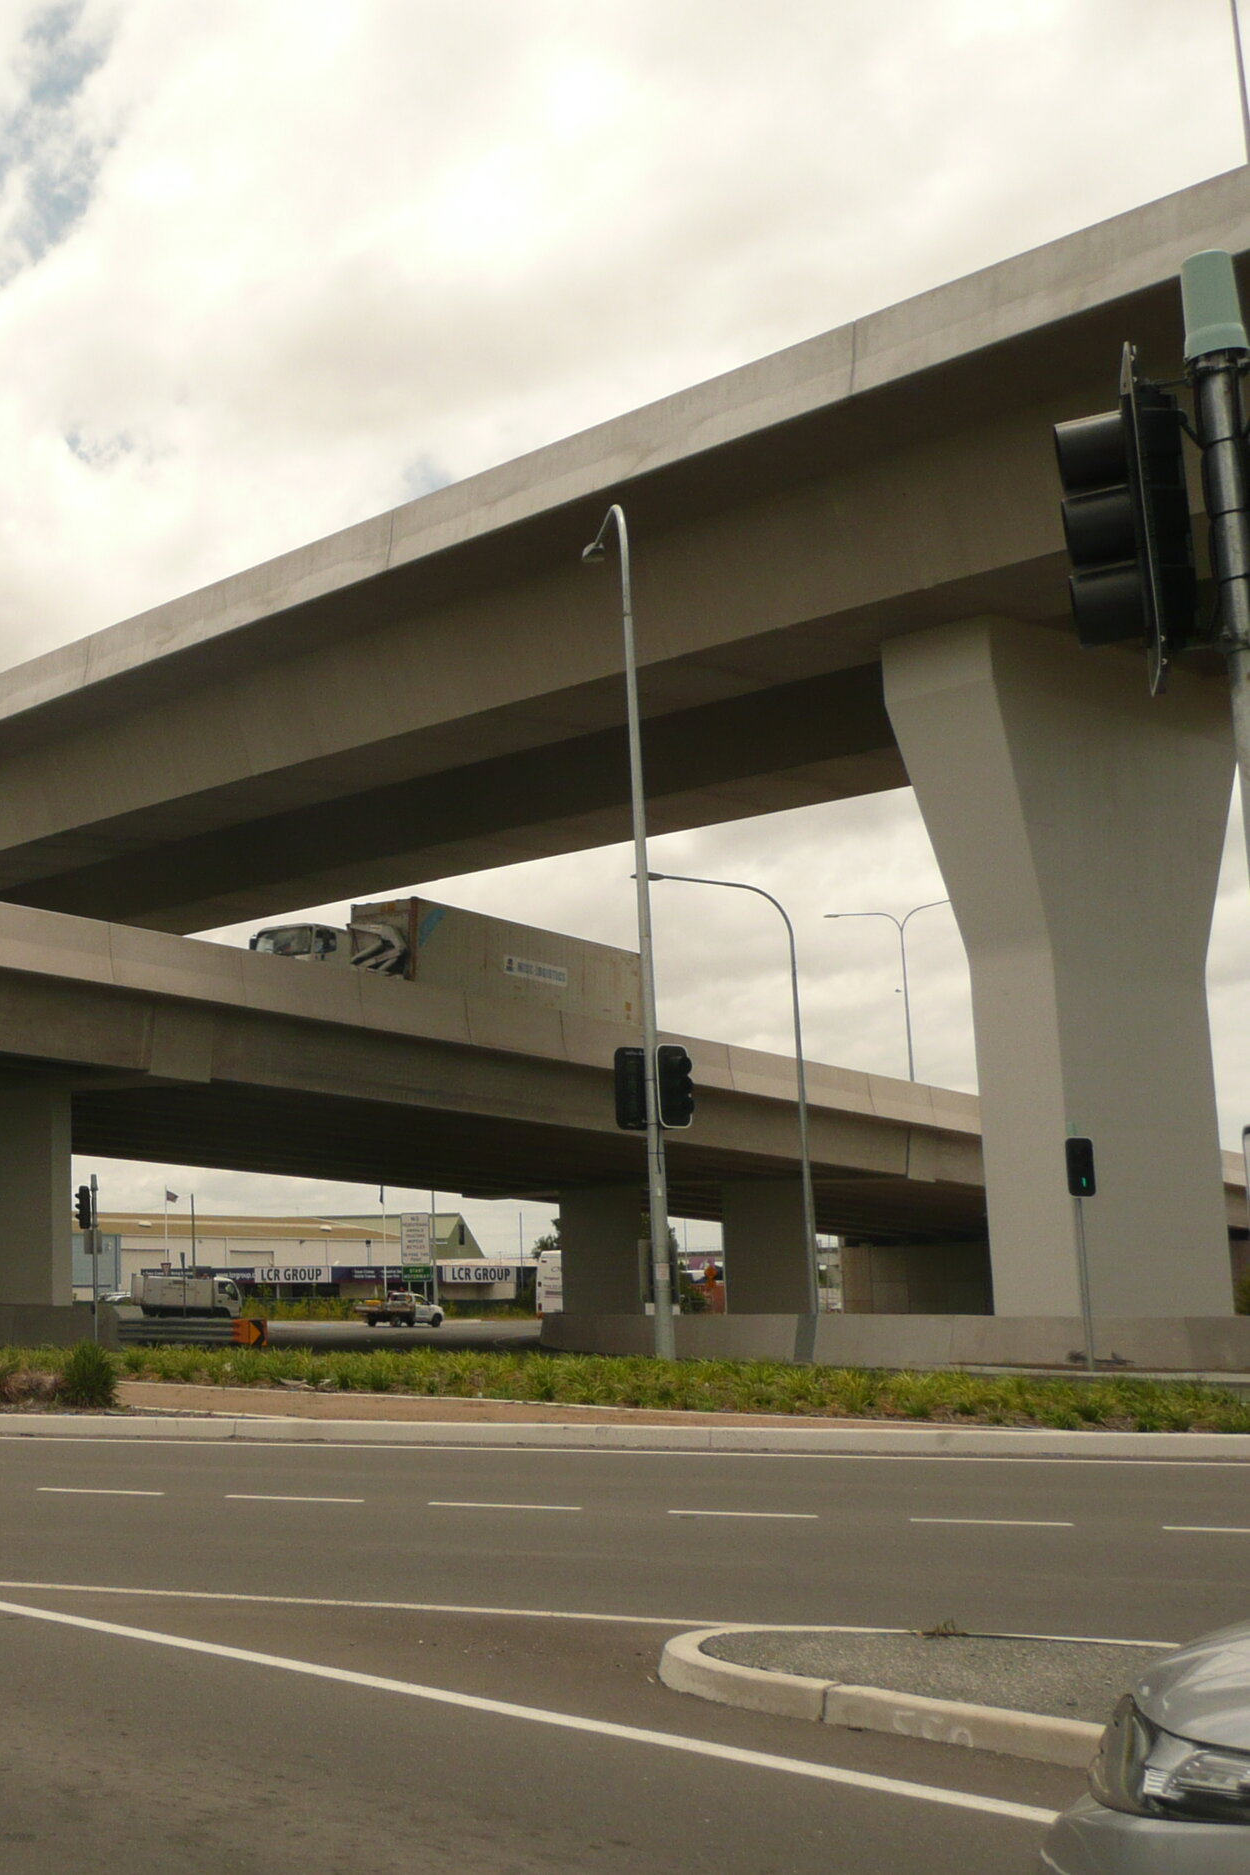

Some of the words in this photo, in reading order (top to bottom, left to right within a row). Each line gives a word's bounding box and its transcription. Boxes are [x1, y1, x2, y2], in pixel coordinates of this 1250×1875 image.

[261, 1269, 280, 1282] LCR
[283, 1268, 322, 1282] GROUP
[452, 1268, 470, 1281] LCR
[474, 1267, 511, 1281] GROUP
